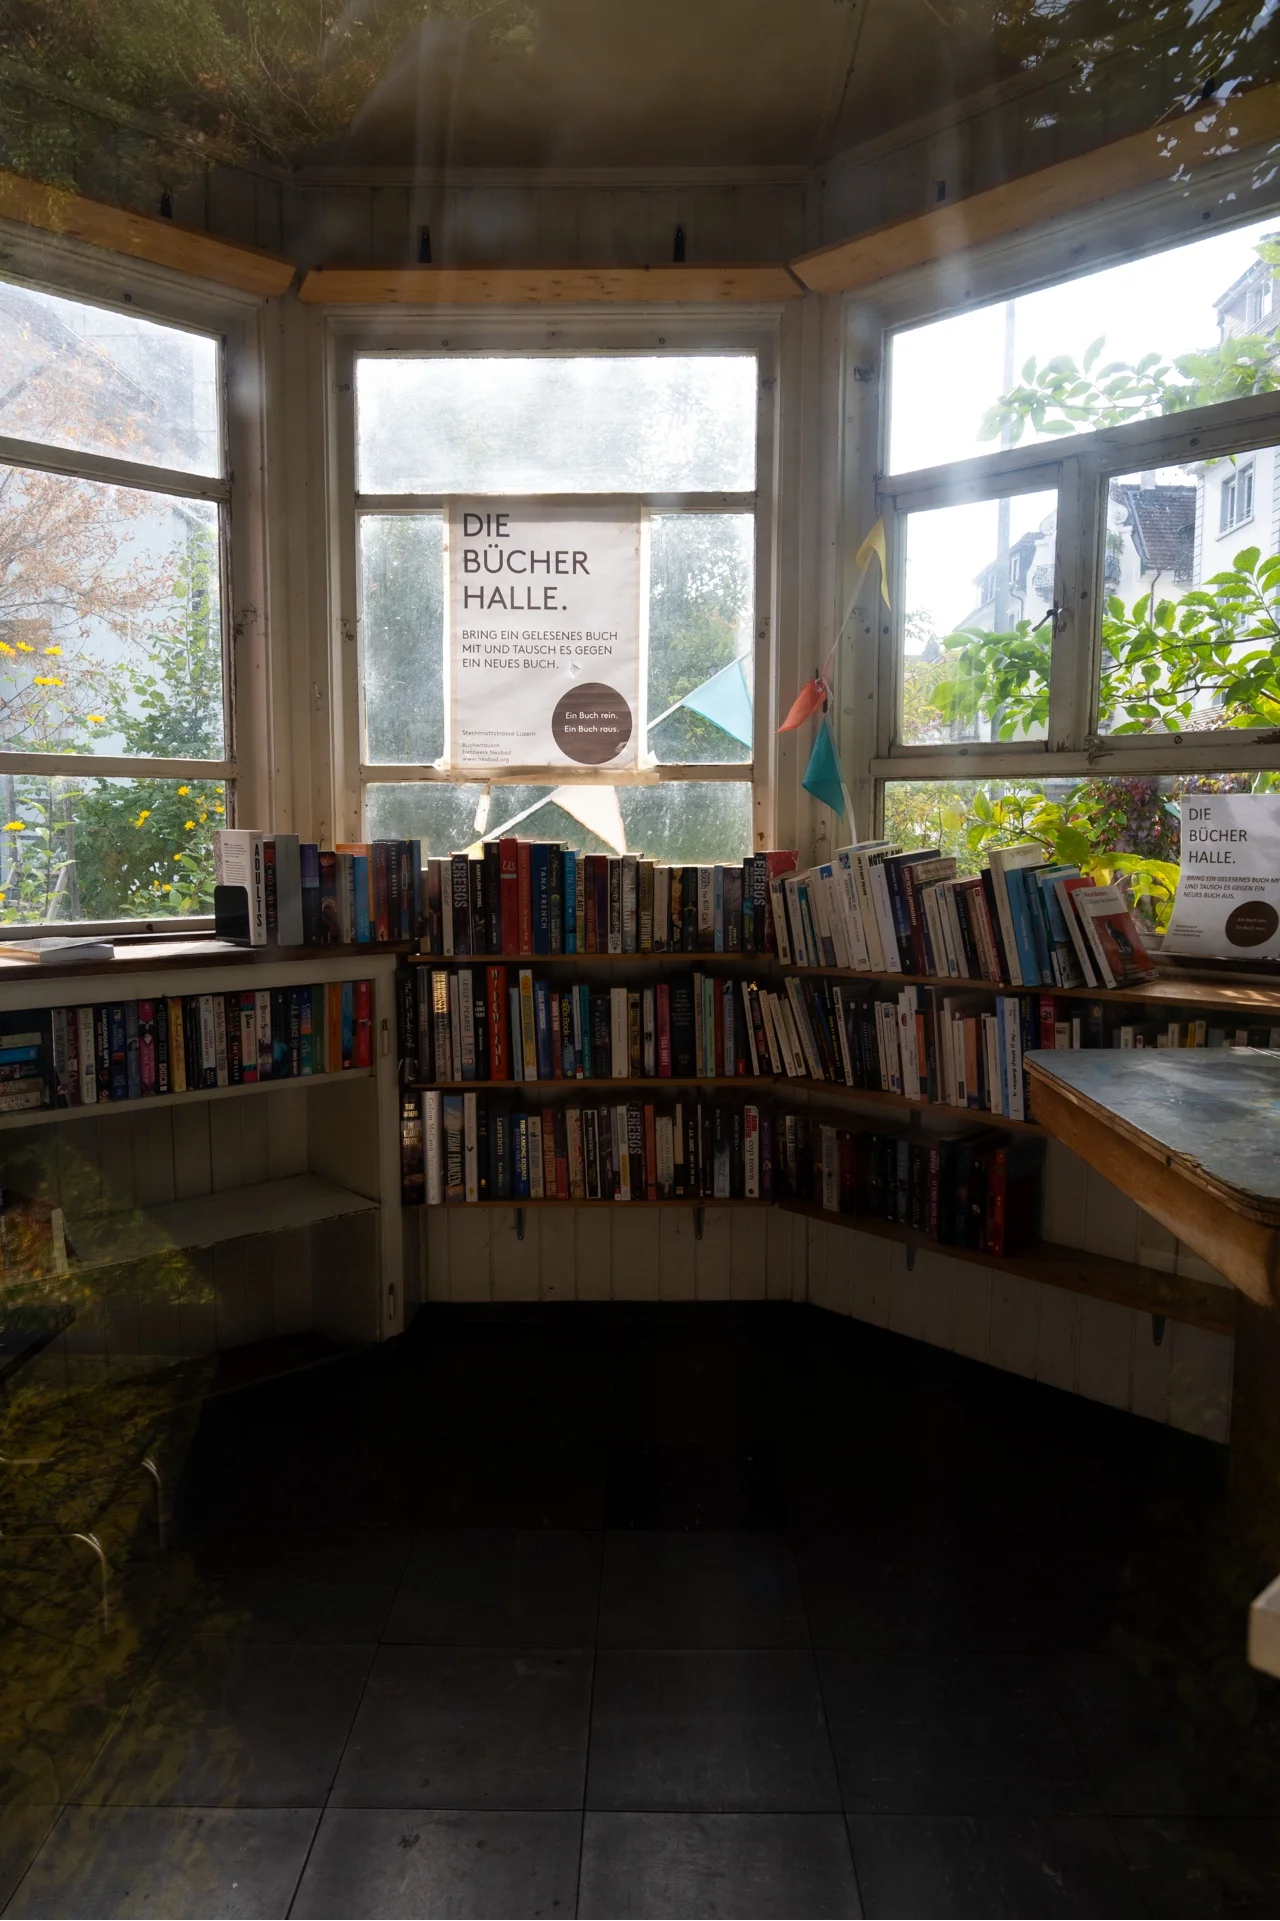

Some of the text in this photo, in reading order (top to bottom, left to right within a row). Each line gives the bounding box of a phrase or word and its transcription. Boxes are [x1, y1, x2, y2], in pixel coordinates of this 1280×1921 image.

[463, 513, 510, 538] DIE
[463, 543, 590, 575] BÜCHER
[463, 586, 567, 611] HALLE.
[462, 630, 618, 641] BRING EIN GELESENES BUCH
[462, 644, 612, 655] MIT UND TAUSCH ES GEGEN
[462, 658, 559, 669] EIN NEUES BUCH.
[565, 711, 619, 720] Ein Buch rein.
[564, 725, 619, 733] Ein Buch raus.
[1189, 808, 1211, 820] DIE
[1189, 827, 1247, 842] BÜCHER
[1188, 851, 1236, 864] HALLE.
[254, 843, 262, 928] ADULTS
[453, 863, 467, 908] EREBOS
[701, 869, 709, 889] Booth
[754, 860, 765, 906] EREBOS
[904, 867, 918, 926] ENTREMONT ESCALADES
[641, 912, 650, 949] LABYRINTH
[562, 1017, 570, 1036] Book
[463, 1035, 473, 1066] LIAR
[158, 1063, 168, 1086] SHOCK
[428, 1123, 436, 1151] McCann
[544, 1133, 554, 1151] JAMES
[628, 1111, 641, 1155] EREBOS
[747, 1140, 755, 1155] cop
[448, 1153, 461, 1186] FRANZEN
[545, 1152, 556, 1182] PATTERSON
